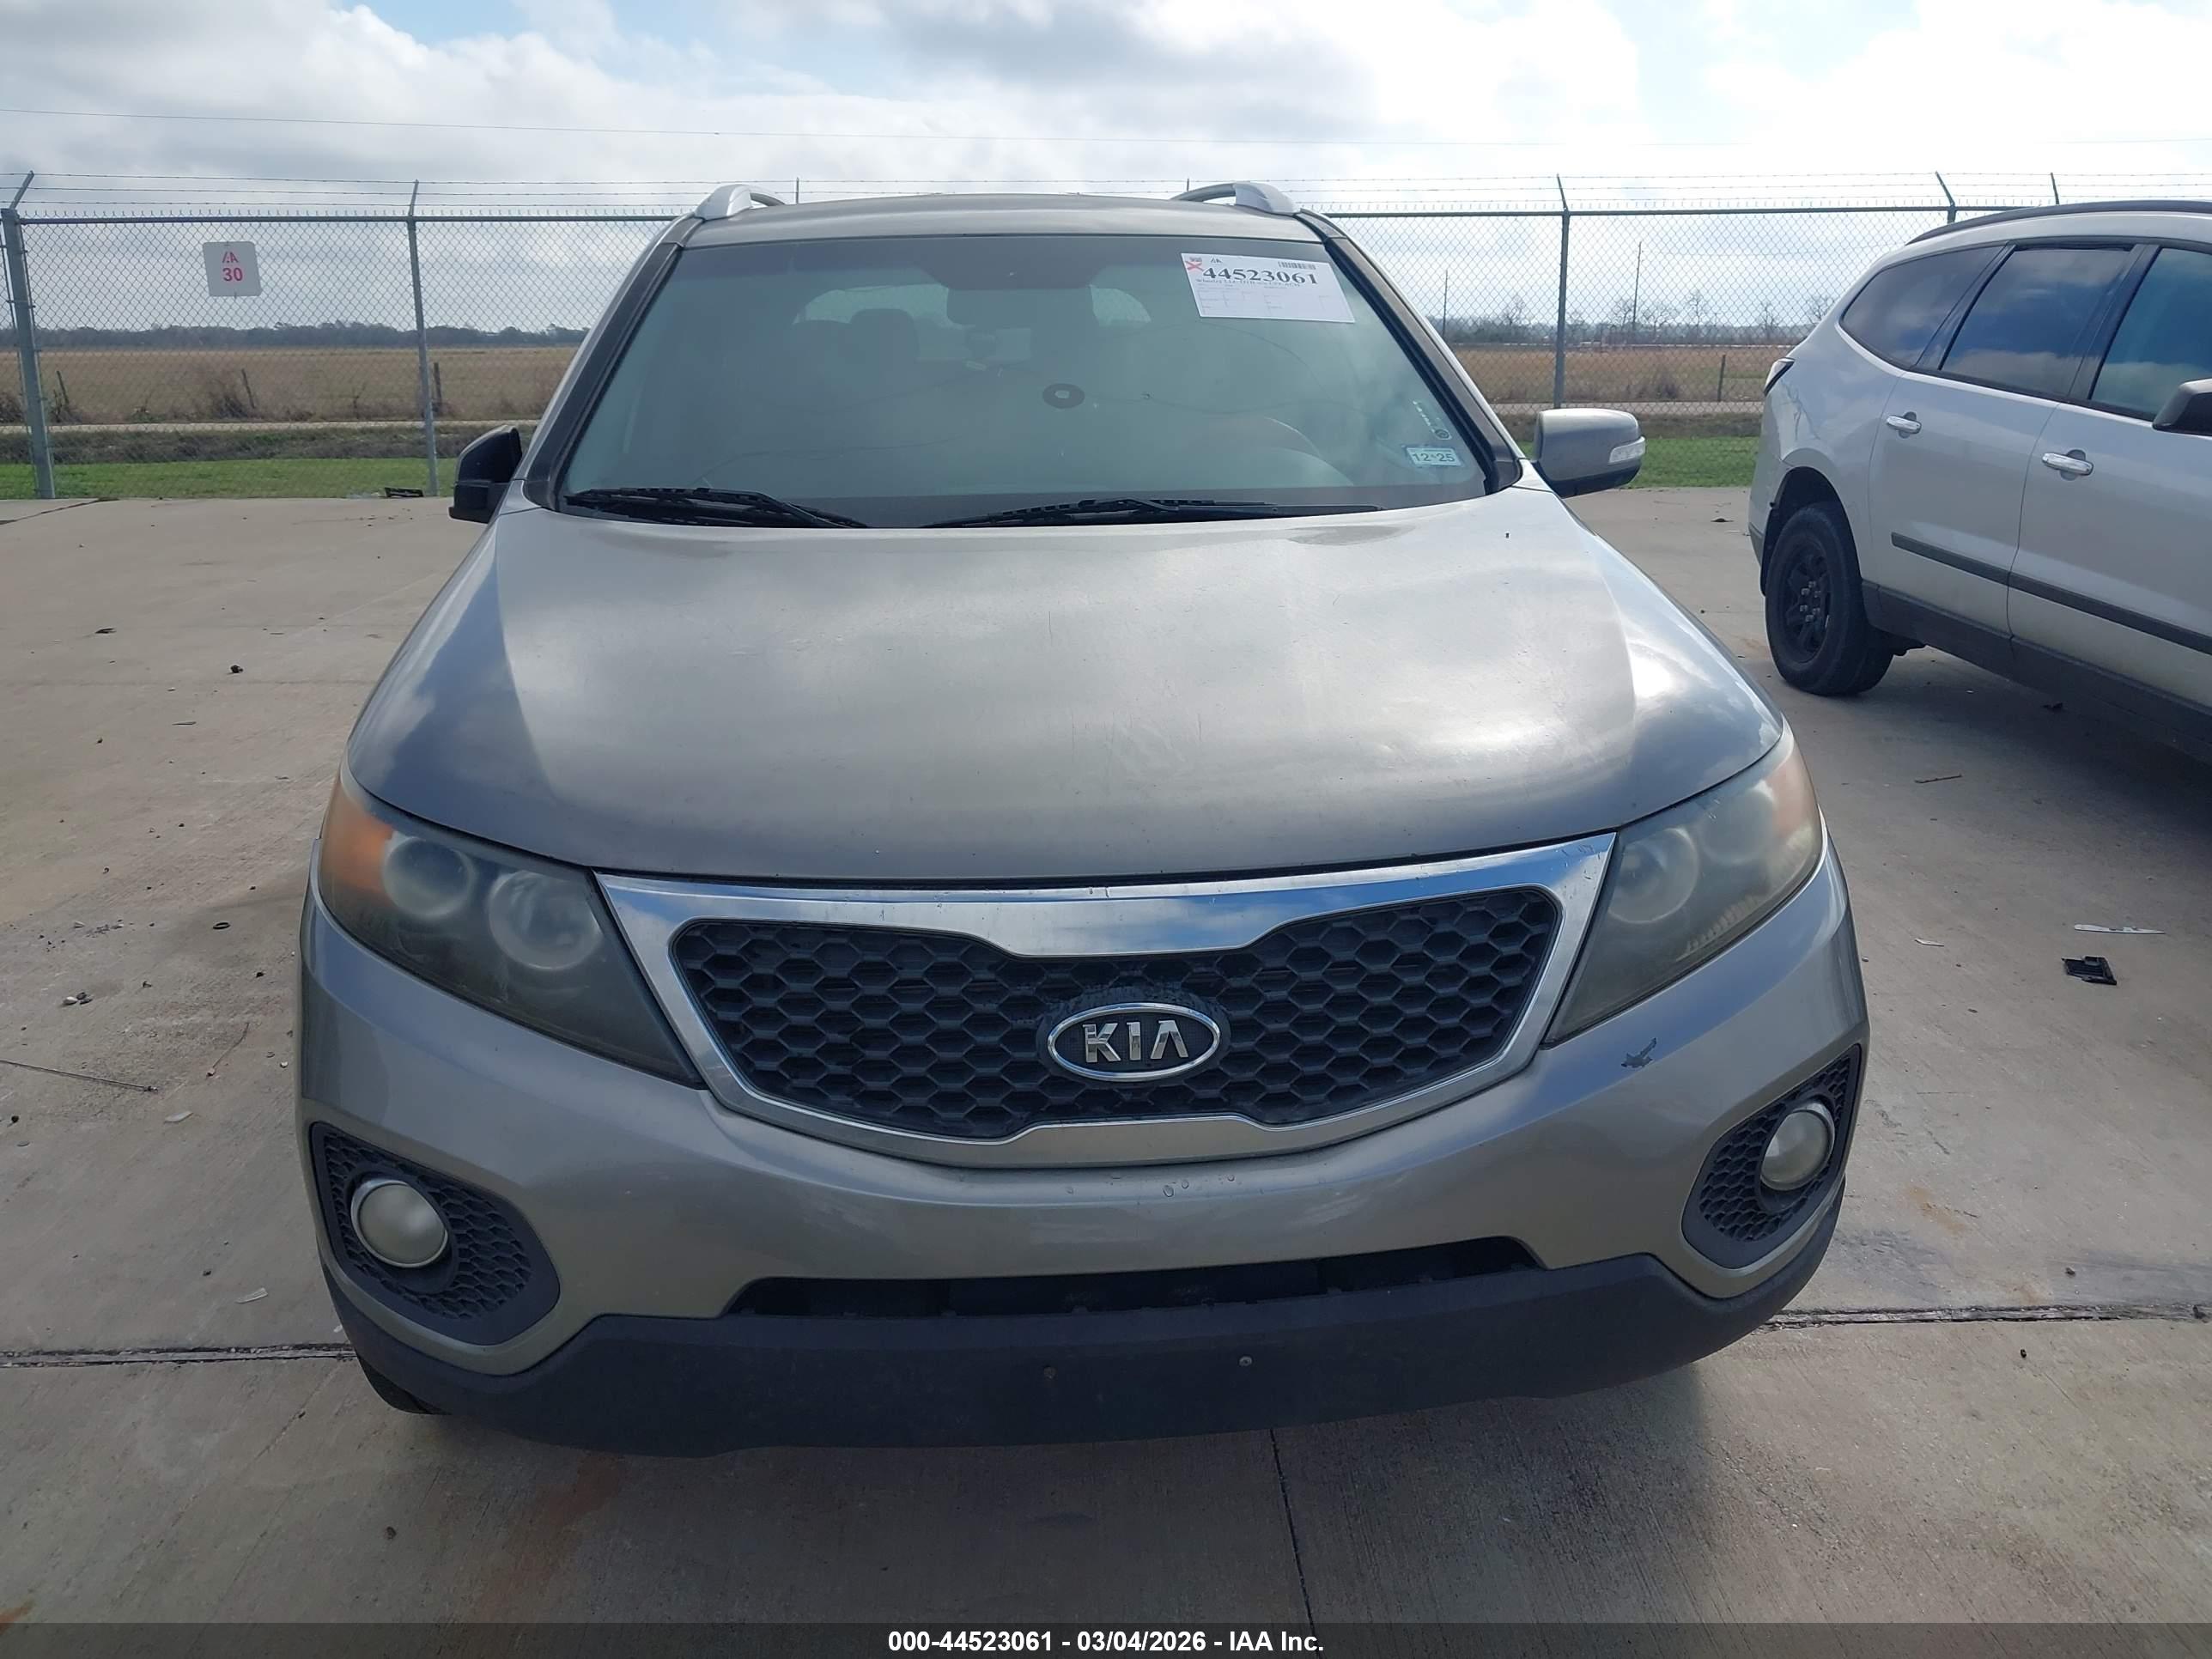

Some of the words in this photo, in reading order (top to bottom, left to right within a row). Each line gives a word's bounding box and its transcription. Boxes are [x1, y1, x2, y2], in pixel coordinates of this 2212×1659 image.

[222, 267, 243, 282] 30
[1203, 267, 1318, 284] 44523061
[1413, 453, 1431, 462] 12
[1436, 453, 1455, 462] 25
[1083, 1019, 1189, 1063] KIA
